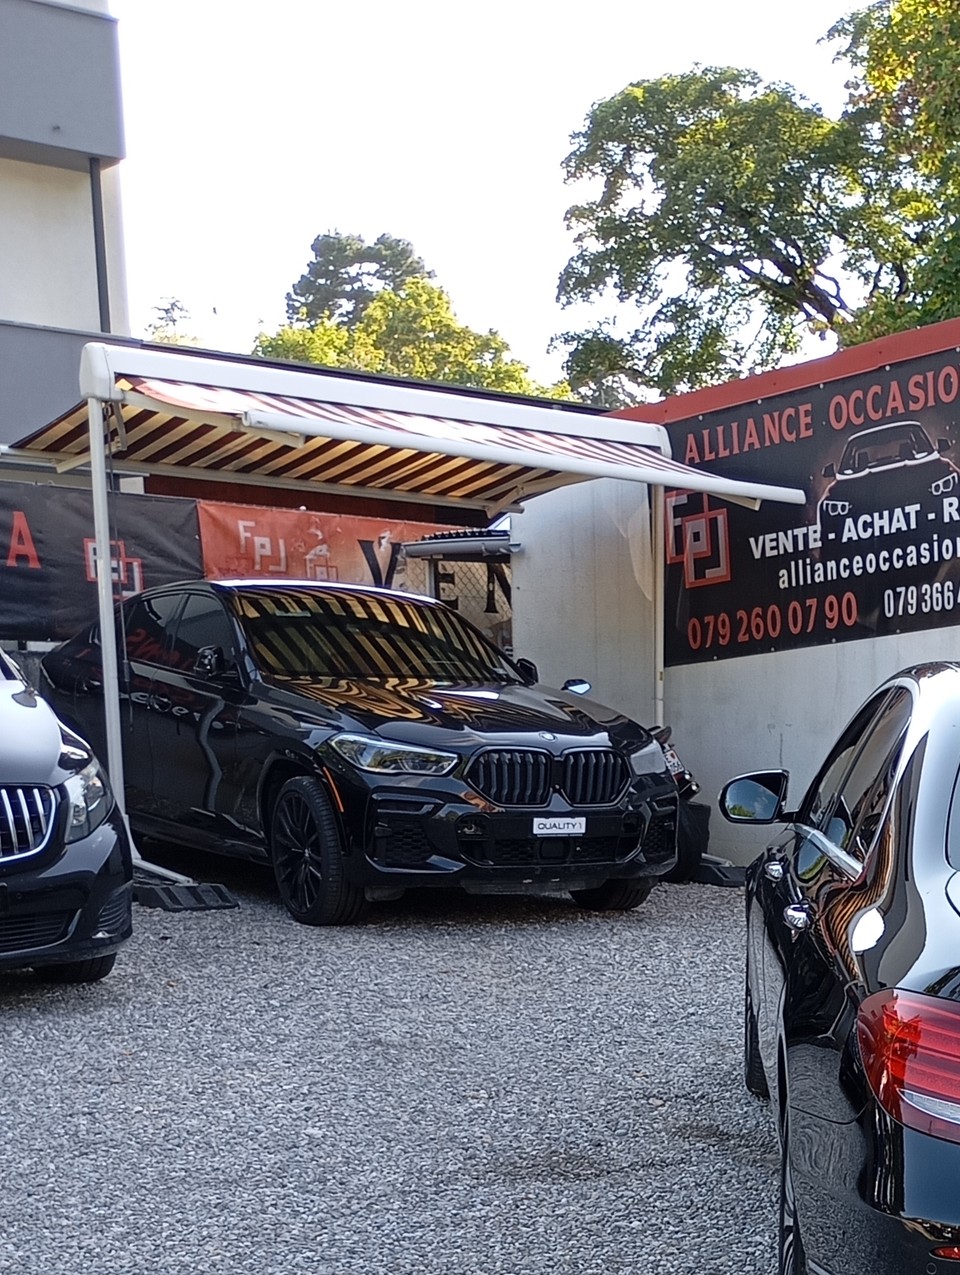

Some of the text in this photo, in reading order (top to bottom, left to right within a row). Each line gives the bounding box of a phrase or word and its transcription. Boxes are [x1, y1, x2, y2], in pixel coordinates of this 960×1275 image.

[684, 403, 814, 465] ALLIANCE
[6, 511, 42, 569] A
[749, 524, 823, 560] VENTE
[841, 503, 921, 544] ACHAT
[687, 591, 859, 650] 079 260 07 90
[537, 822, 577, 830] QUALITY
